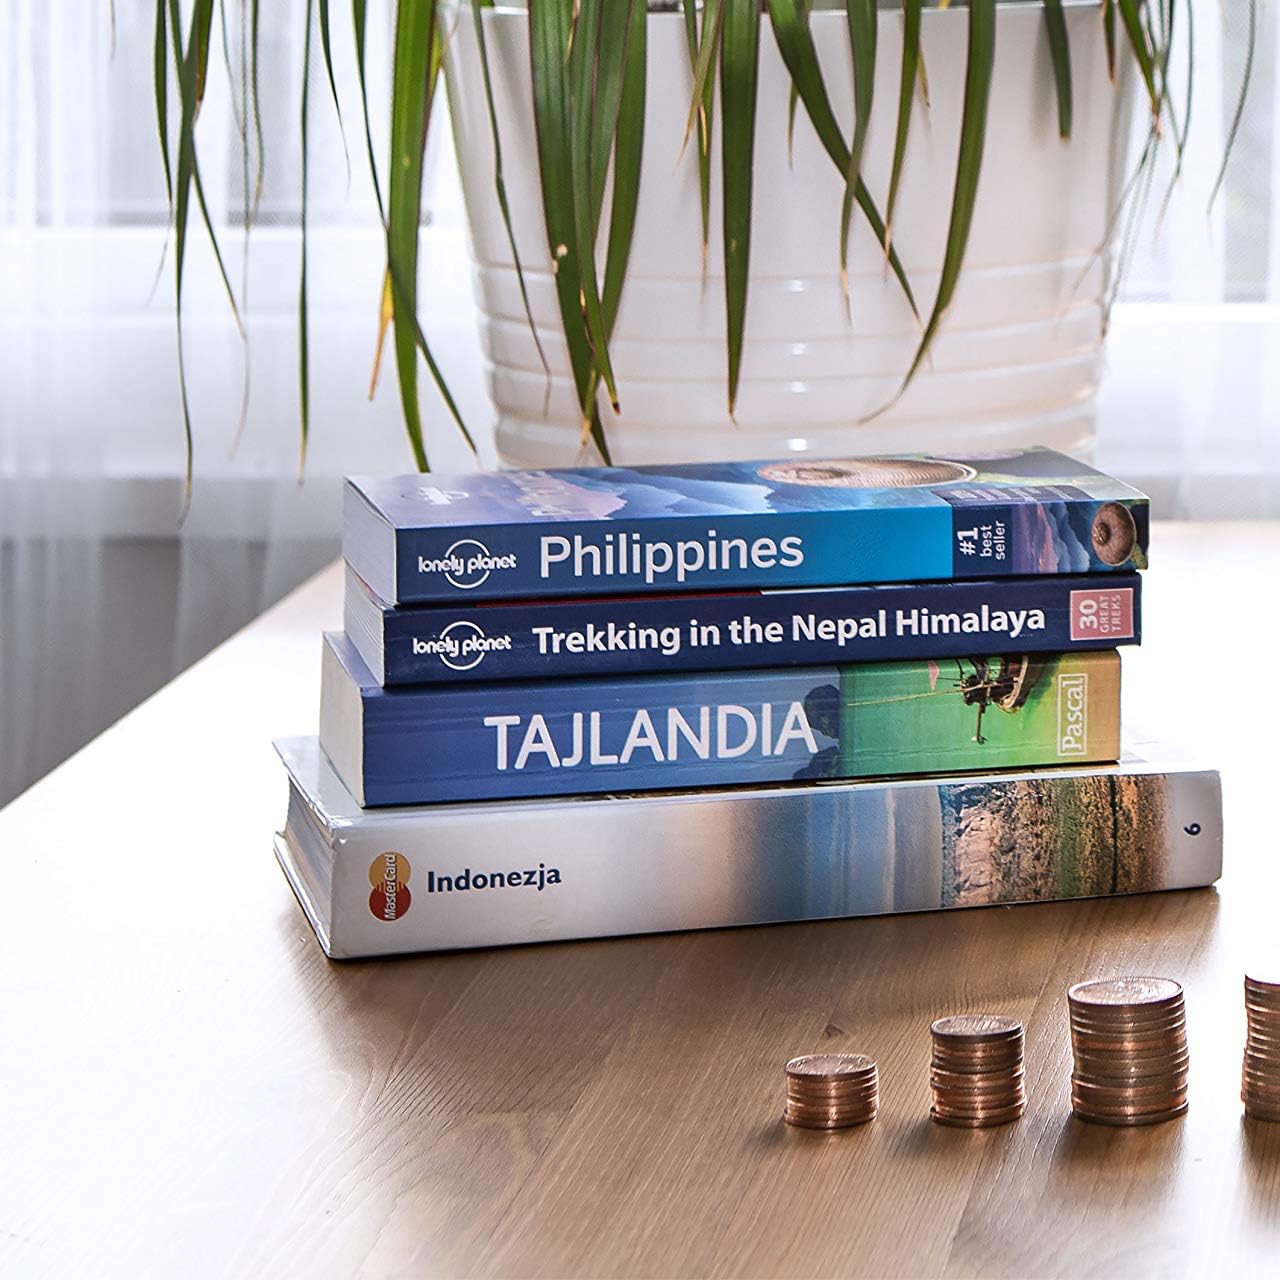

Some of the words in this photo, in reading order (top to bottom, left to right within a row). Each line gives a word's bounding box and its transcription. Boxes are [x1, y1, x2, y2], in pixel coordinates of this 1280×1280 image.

[540, 530, 805, 584] Philippines
[956, 527, 979, 556] #1
[980, 524, 993, 557] best
[993, 520, 1006, 560] seller
[418, 554, 464, 576] lonely
[466, 553, 517, 574] planet
[532, 622, 681, 655] Trekking
[689, 619, 721, 646] in
[728, 616, 783, 644] the
[792, 609, 887, 646] Nepal
[895, 604, 1046, 638] Himalaya
[1079, 599, 1098, 630] 30
[1099, 595, 1110, 633] GREAT
[1111, 594, 1121, 633] TREKS
[412, 636, 460, 658] lonely
[461, 635, 512, 656] planet
[1061, 677, 1084, 752] Pascal
[483, 701, 819, 771] TAJLANDIA
[384, 854, 397, 919] MasterCard
[427, 863, 562, 893] Indonezja
